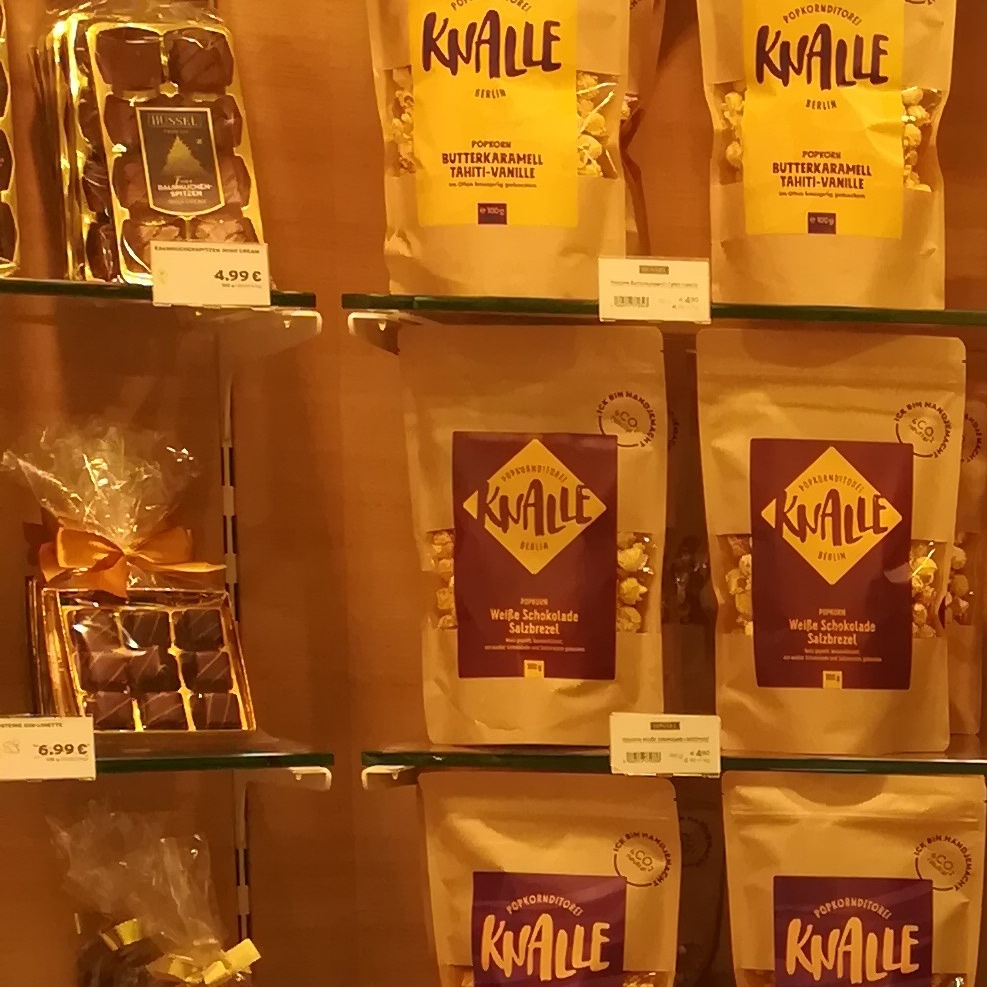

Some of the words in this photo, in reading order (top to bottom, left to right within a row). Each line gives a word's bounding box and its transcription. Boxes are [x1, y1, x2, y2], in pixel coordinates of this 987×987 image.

[782, 4, 862, 27] POPKORNDITOREI
[422, 10, 562, 79] KNALLE
[756, 23, 889, 91] KNALLE
[474, 88, 507, 99] BERLIN
[805, 99, 838, 110] BERLIN
[471, 140, 511, 148] POPKORN
[442, 152, 543, 165] BUTTERKARAMELL
[802, 151, 842, 159] POPKORN
[450, 166, 536, 179] TAHITI-VANILLE
[772, 162, 872, 176] BUTTERKARAMELL
[780, 175, 865, 189] TAHITI-VANILLE
[474, 478, 593, 537] KNALLE
[772, 488, 890, 548] KNALLE
[490, 608, 520, 621] Weiße
[522, 608, 579, 622] Schokolade
[508, 622, 560, 635] Salzbrezel
[789, 619, 819, 632] Weiße
[820, 619, 876, 633] Schokolade
[807, 632, 858, 646] Salzbrezel
[813, 897, 892, 920] POPKORNDITOREI
[481, 913, 611, 982] KNALLE
[785, 917, 920, 985] KNALLE
